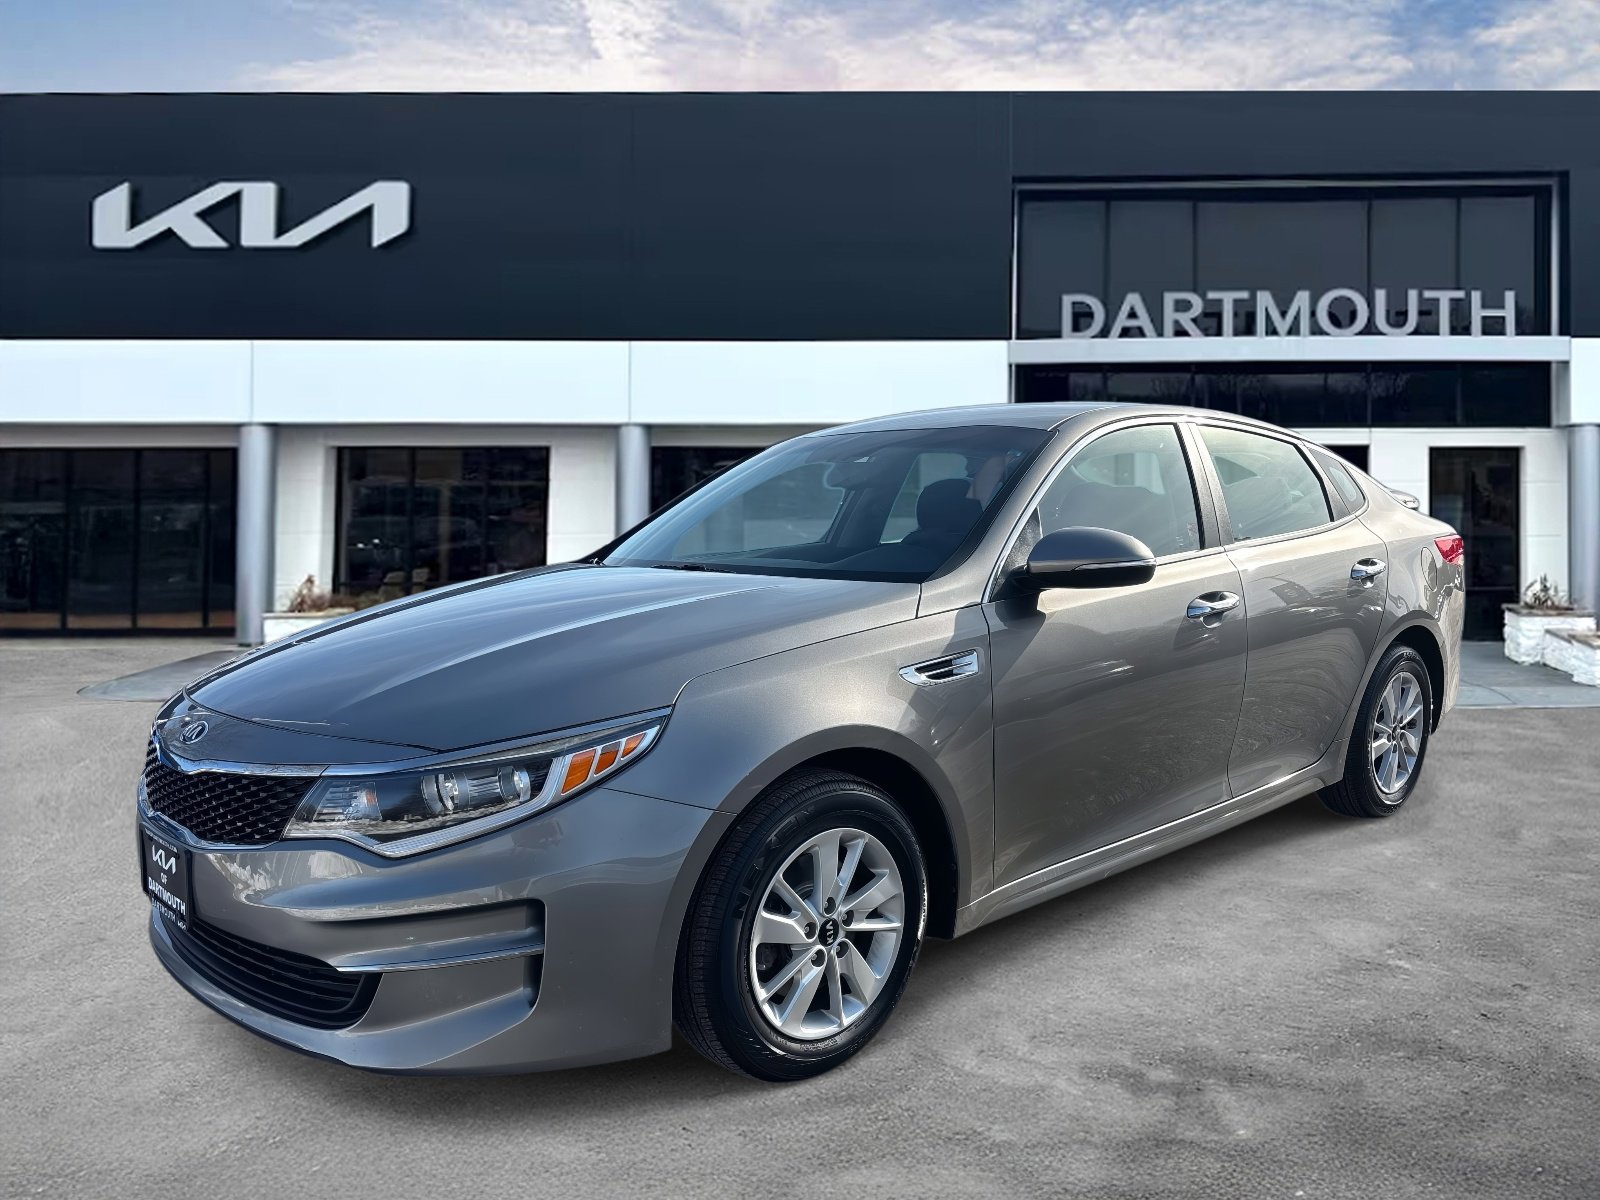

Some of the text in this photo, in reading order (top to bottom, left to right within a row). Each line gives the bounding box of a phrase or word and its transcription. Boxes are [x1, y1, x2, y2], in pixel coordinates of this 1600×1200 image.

[92, 181, 410, 248] KIA
[1061, 288, 1517, 338] DARTMOUTH
[148, 876, 186, 916] DARTMOUTH
[160, 872, 168, 885] OF
